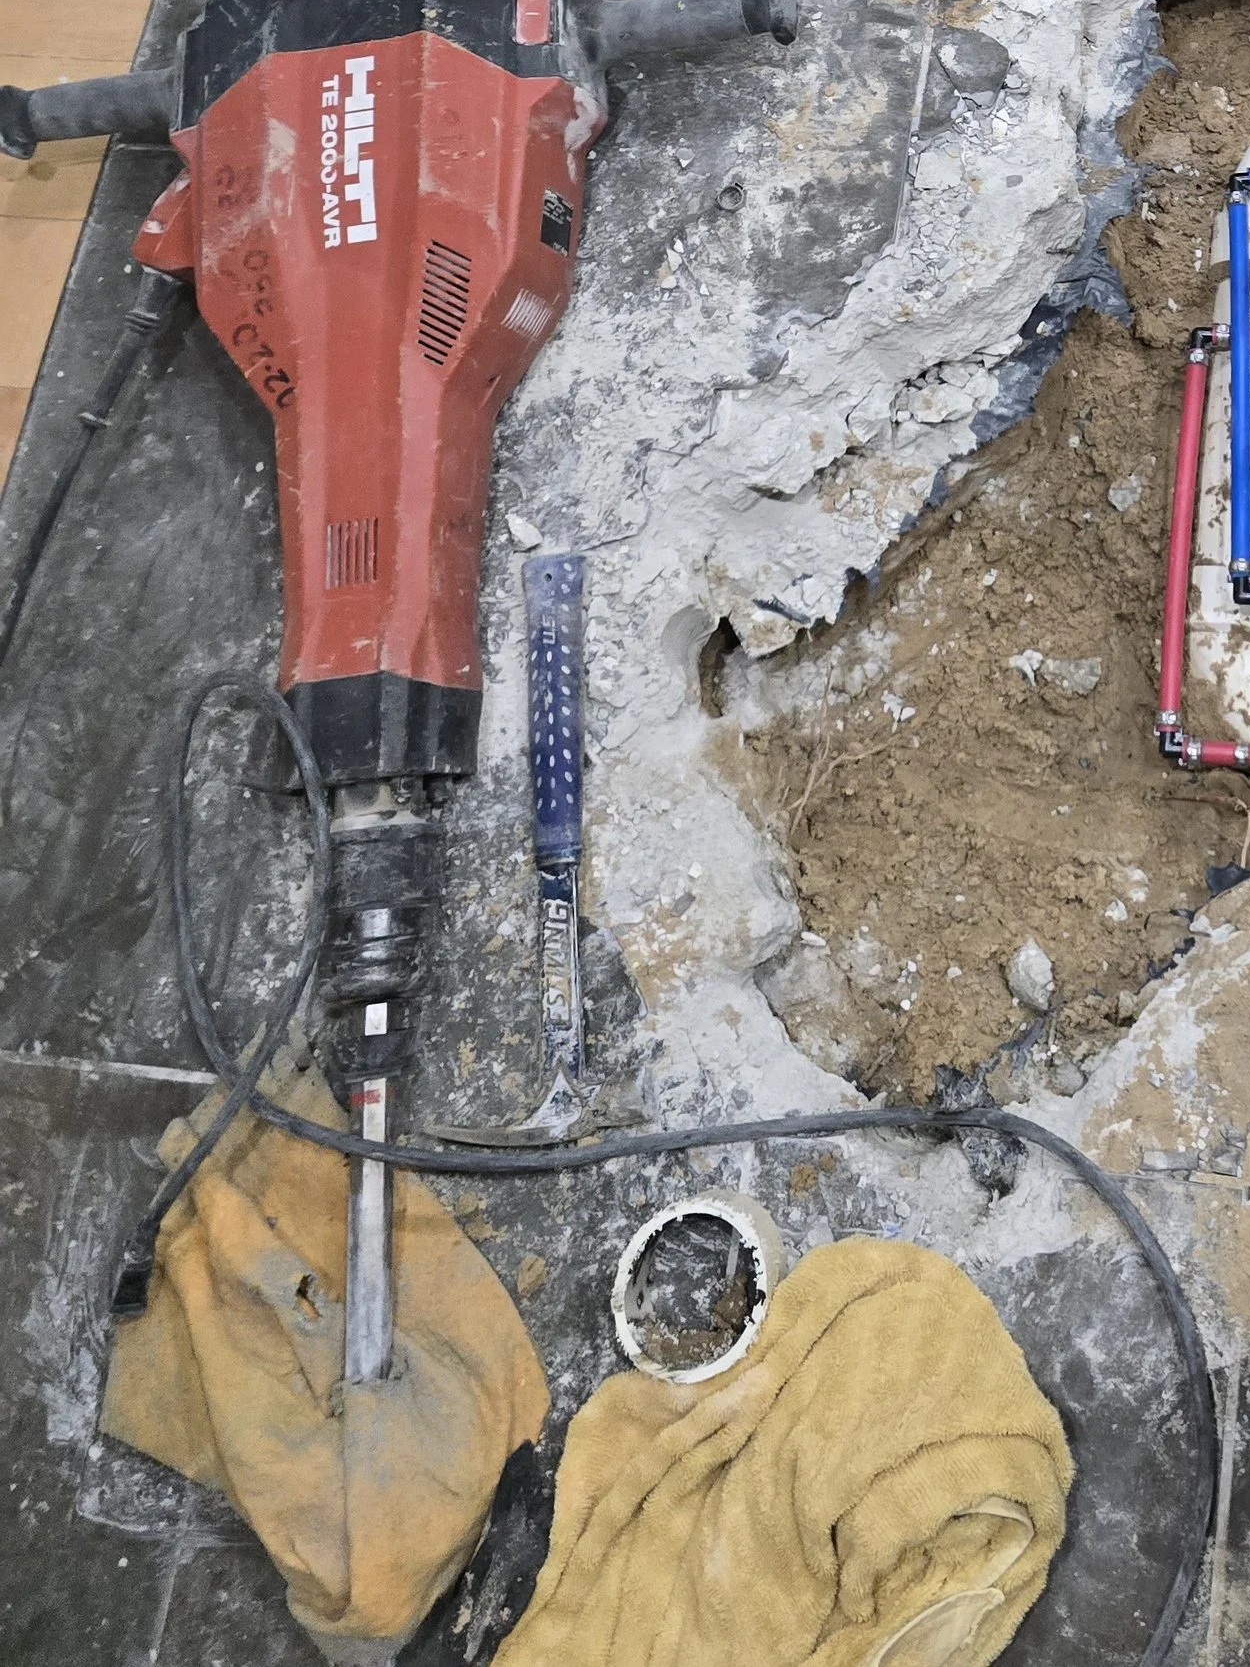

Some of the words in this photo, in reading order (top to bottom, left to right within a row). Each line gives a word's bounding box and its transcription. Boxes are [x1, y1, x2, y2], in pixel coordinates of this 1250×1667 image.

[321, 74, 340, 108] TE
[344, 55, 377, 244] HILTI
[320, 113, 341, 249] 2000-AVR
